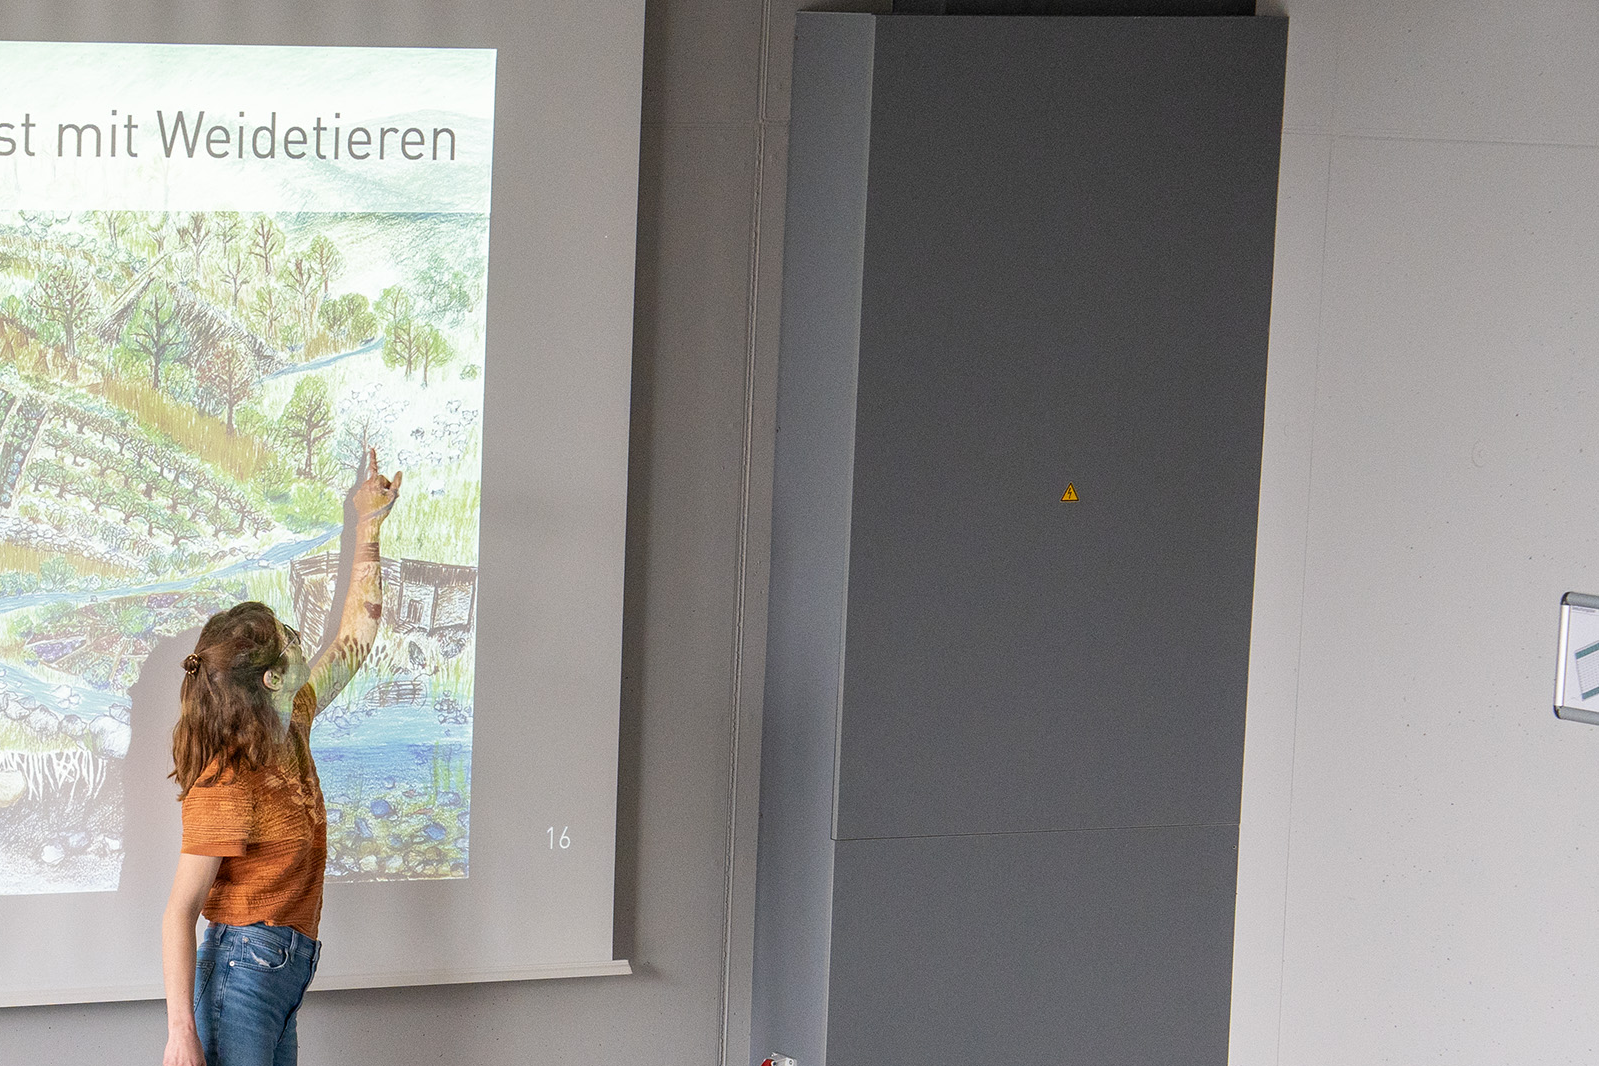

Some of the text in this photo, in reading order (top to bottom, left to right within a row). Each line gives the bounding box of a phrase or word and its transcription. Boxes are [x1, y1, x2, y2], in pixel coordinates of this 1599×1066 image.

[57, 110, 138, 157] mit
[157, 110, 456, 161] Weidetieren
[546, 826, 571, 850] 16
